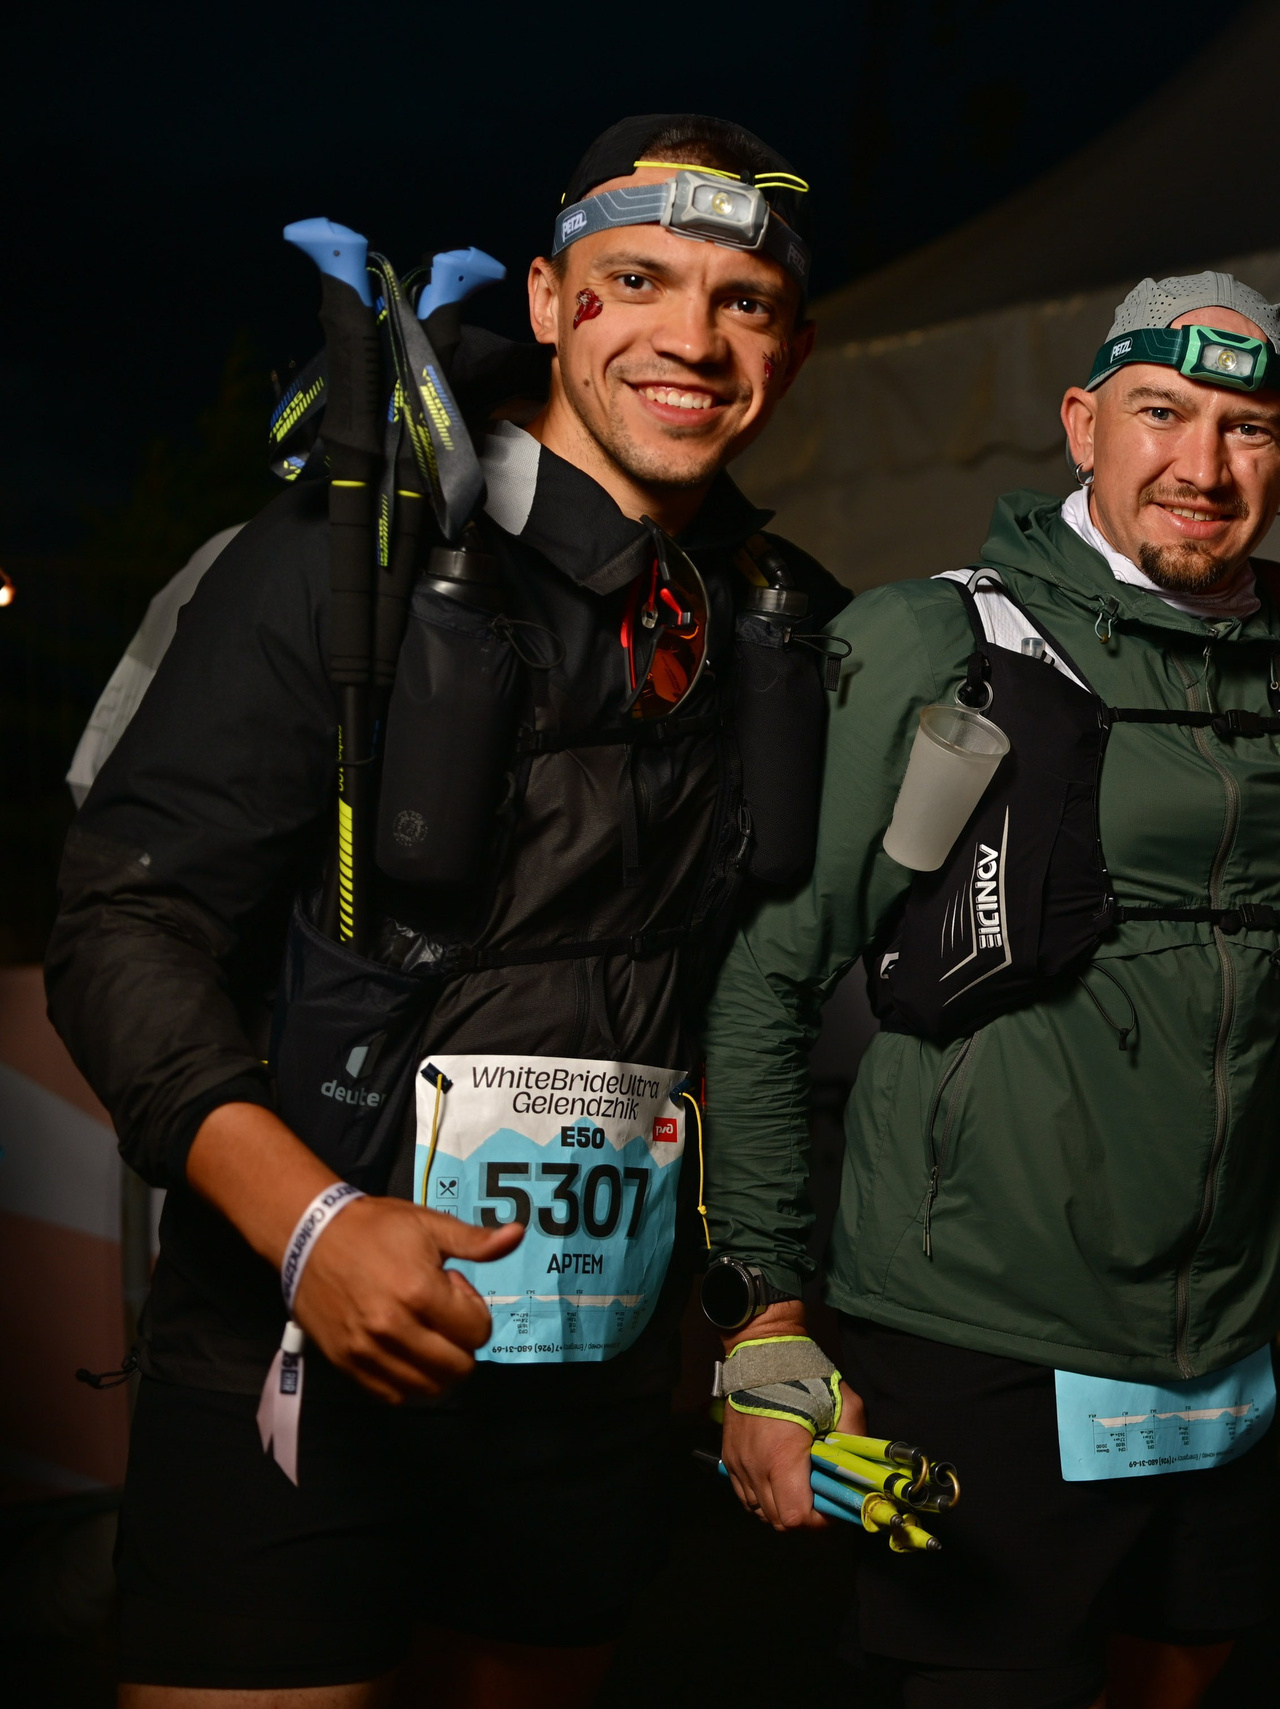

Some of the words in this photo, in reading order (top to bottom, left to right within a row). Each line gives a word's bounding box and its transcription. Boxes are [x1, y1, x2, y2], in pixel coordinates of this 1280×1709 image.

[562, 211, 588, 242] PETZL
[1109, 338, 1133, 364] PETZL
[472, 1066, 660, 1099] WhiteBrideUltra
[512, 1091, 639, 1120] Gelendzhik
[560, 1125, 605, 1149] E50
[477, 1161, 650, 1240] 5307
[546, 1253, 604, 1274] АРТЕМ
